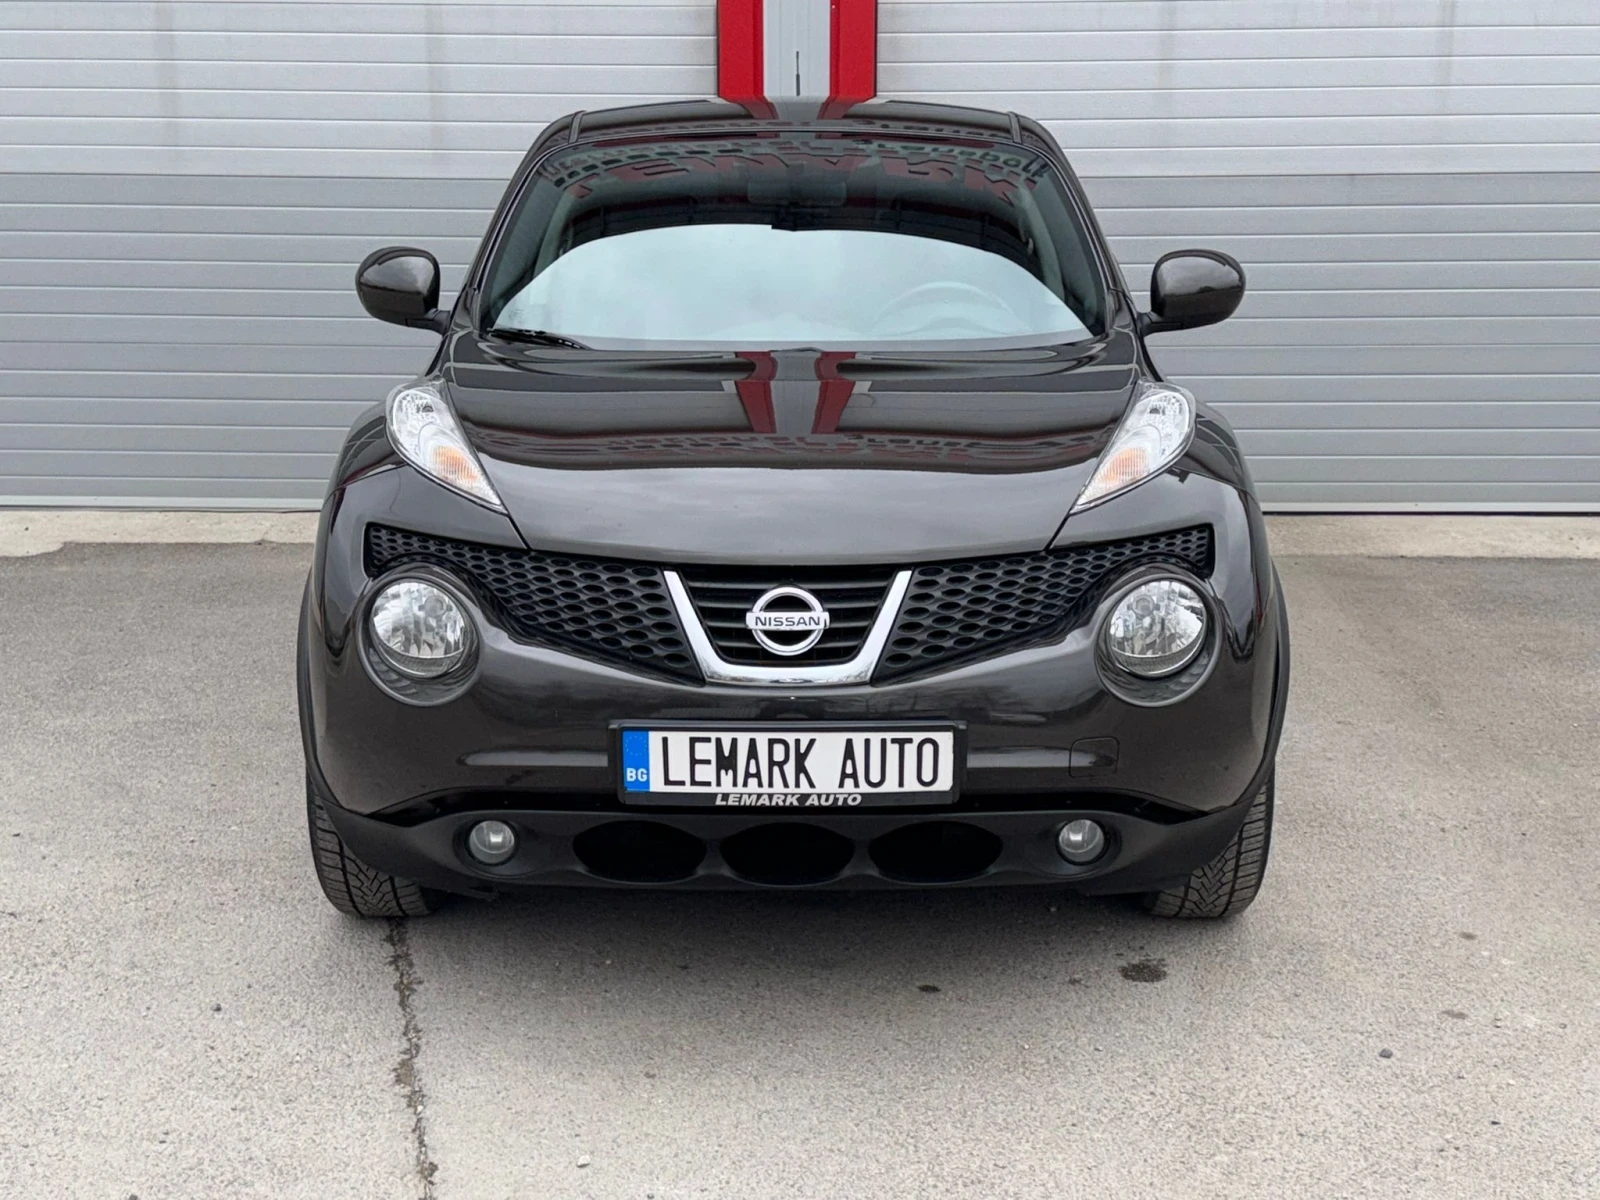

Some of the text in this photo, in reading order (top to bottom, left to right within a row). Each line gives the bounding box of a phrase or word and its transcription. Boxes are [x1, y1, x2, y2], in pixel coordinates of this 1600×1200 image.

[755, 616, 820, 627] NISSAN
[661, 736, 940, 789] LEMARK AUTO
[626, 768, 648, 782] BG
[715, 793, 862, 806] LEMARK AUTO
